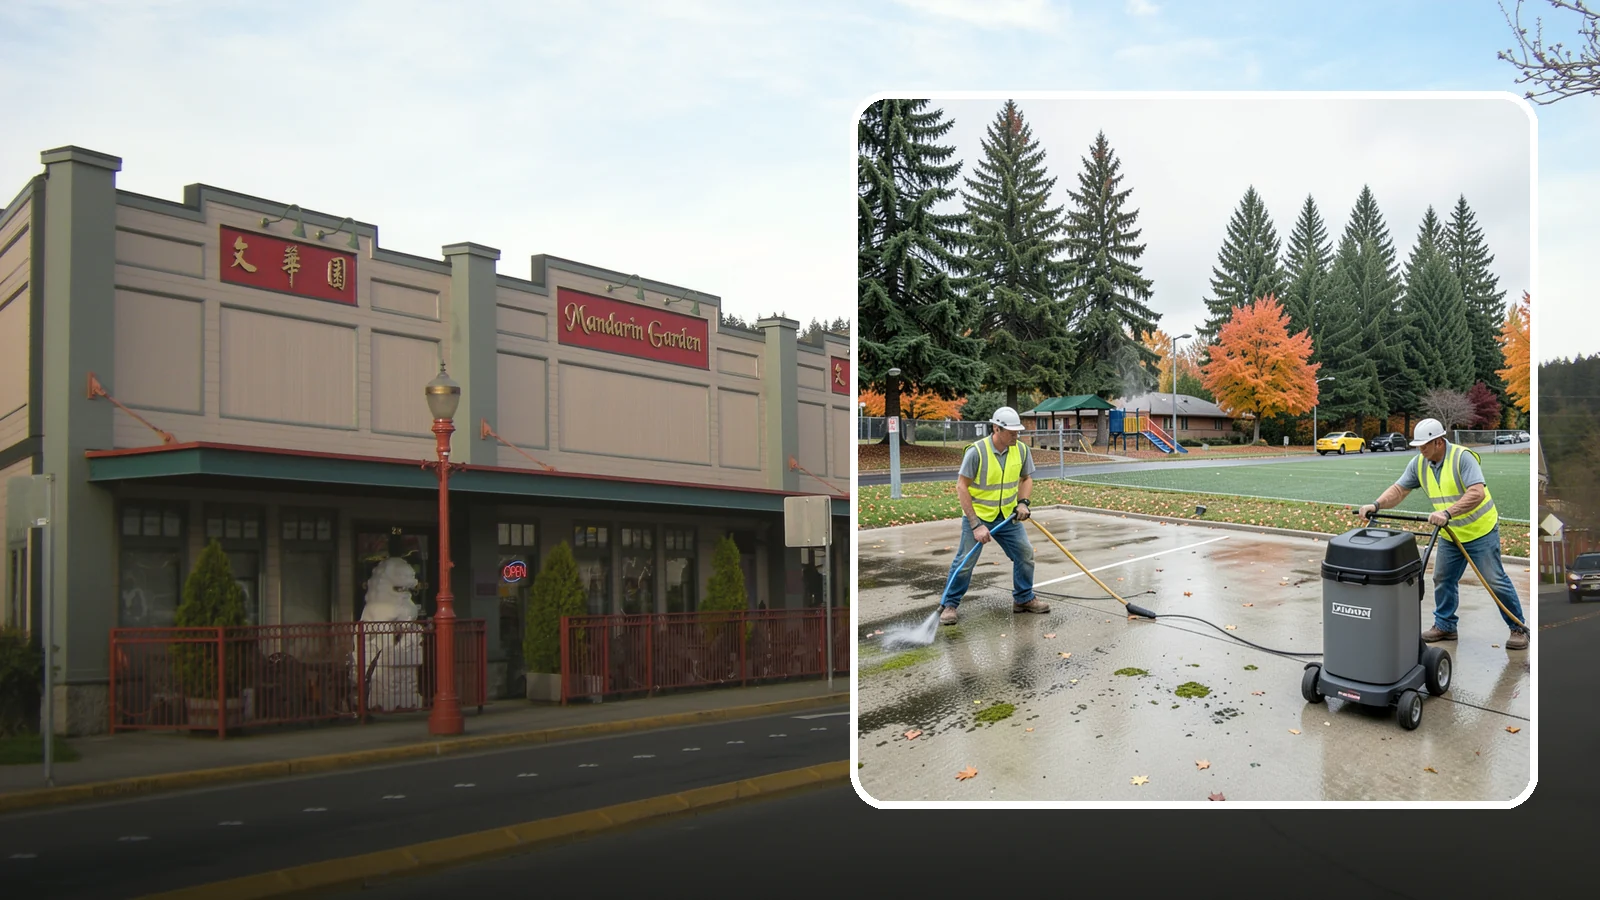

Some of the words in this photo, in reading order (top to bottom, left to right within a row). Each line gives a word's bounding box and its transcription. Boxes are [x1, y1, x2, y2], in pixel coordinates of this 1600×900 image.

[231, 235, 346, 290] 文華園
[564, 302, 644, 341] Mandarin
[648, 320, 701, 352] Garden
[503, 565, 527, 578] OPEN
